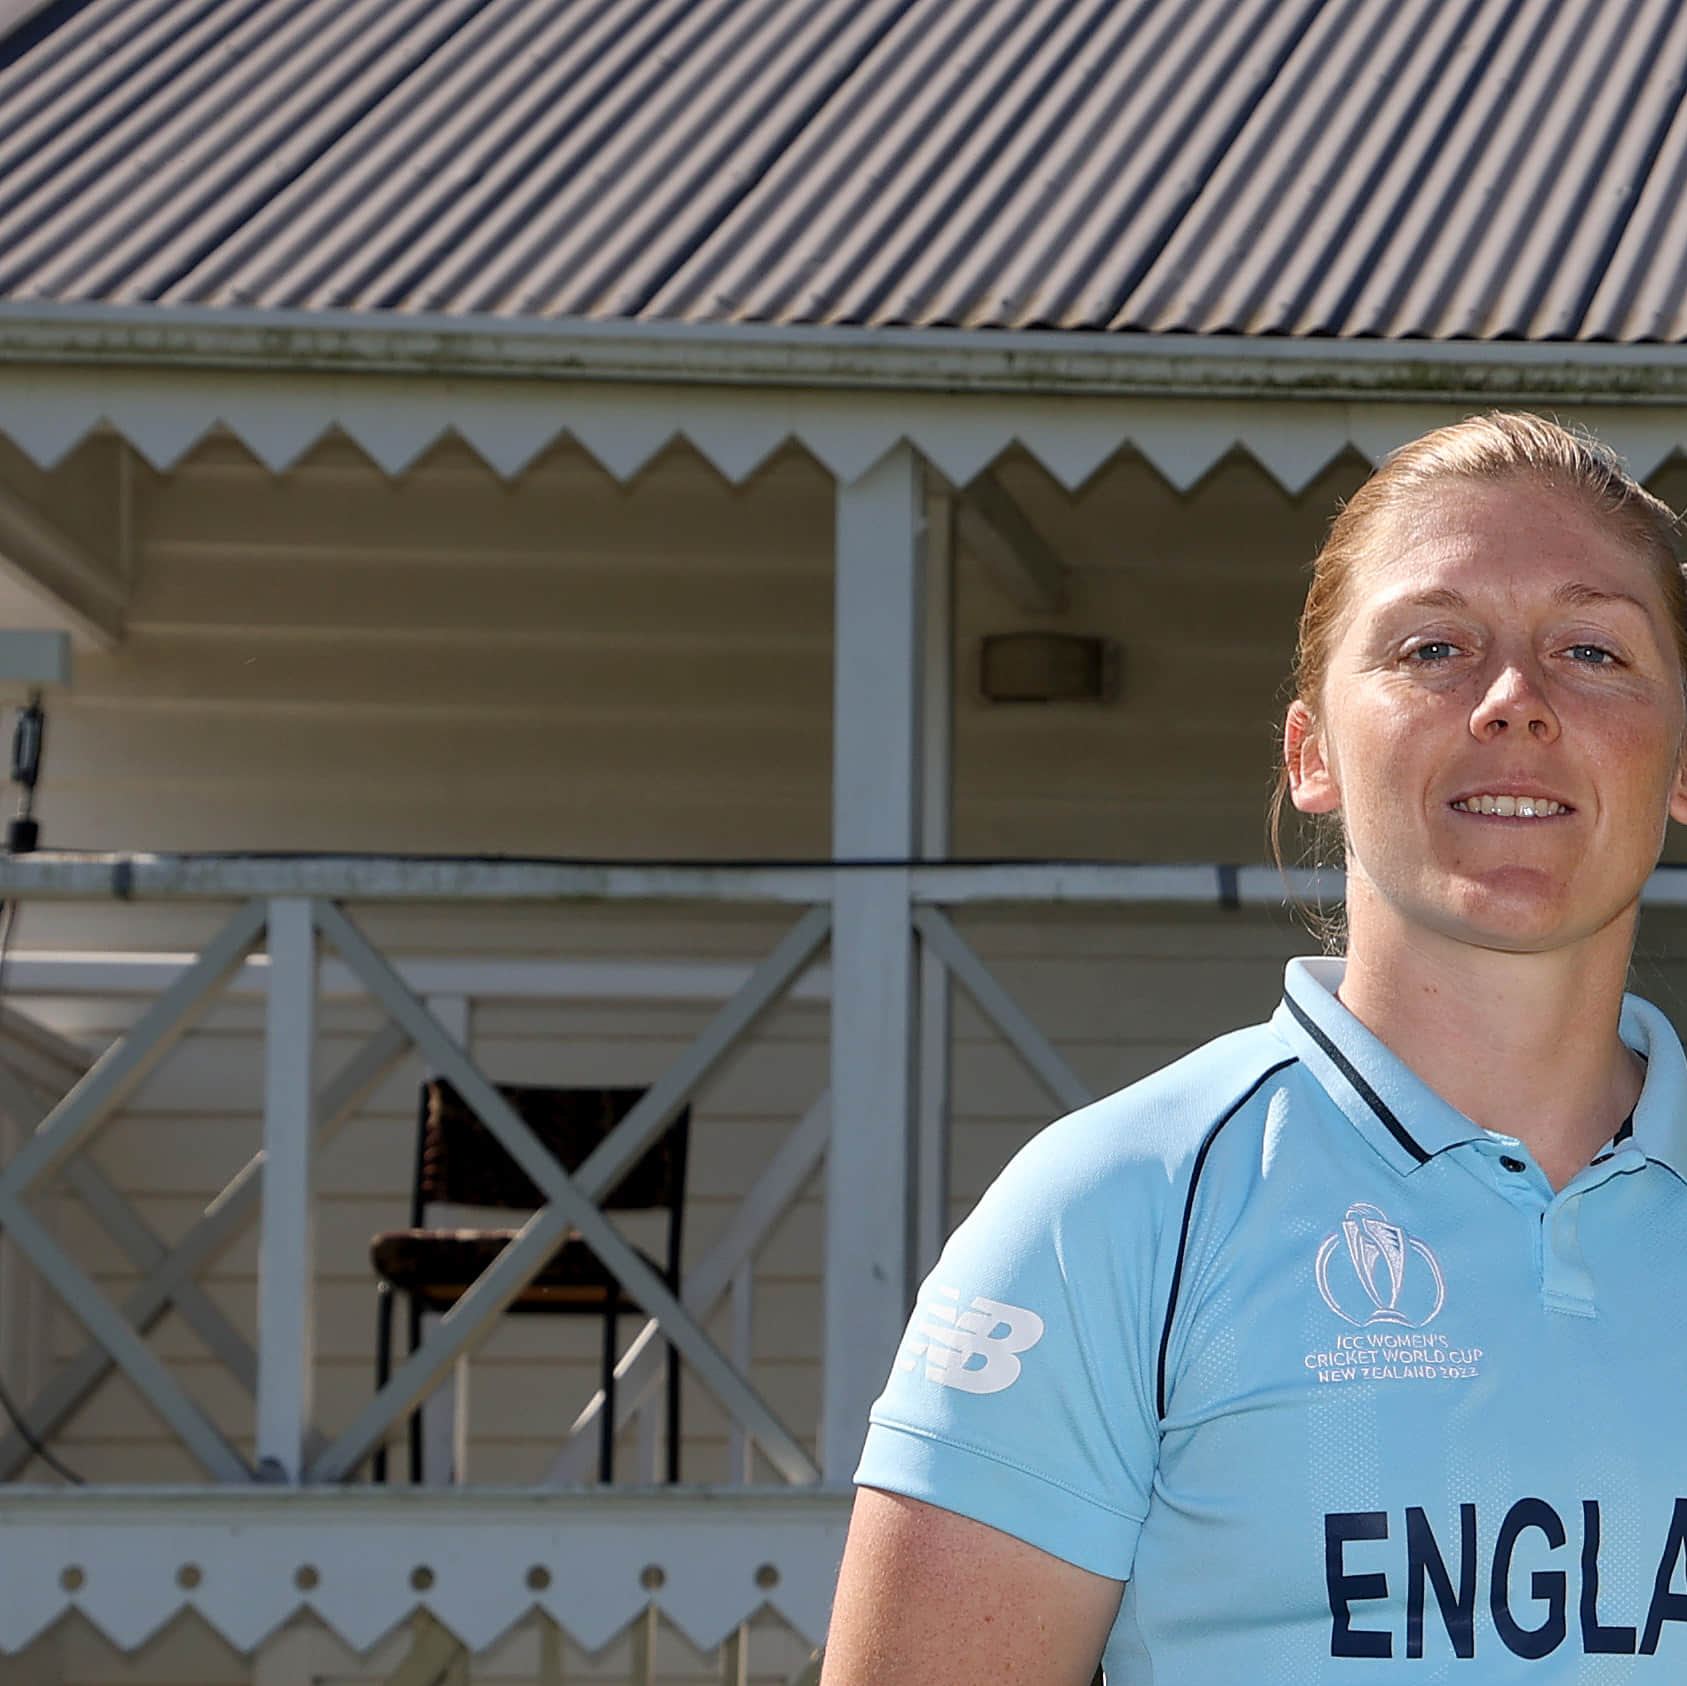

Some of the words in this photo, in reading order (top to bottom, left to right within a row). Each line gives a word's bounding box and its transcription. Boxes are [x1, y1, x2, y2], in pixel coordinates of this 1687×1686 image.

[1336, 1335, 1363, 1350] ICC
[1366, 1333, 1449, 1349] WOMEN'S
[1304, 1349, 1378, 1369] CRICKET
[1382, 1348, 1446, 1365] WORLD
[1449, 1348, 1484, 1364] CUP
[1318, 1368, 1356, 1383] NEW
[1361, 1366, 1437, 1380] ZEALAND
[1440, 1366, 1479, 1379] 2022
